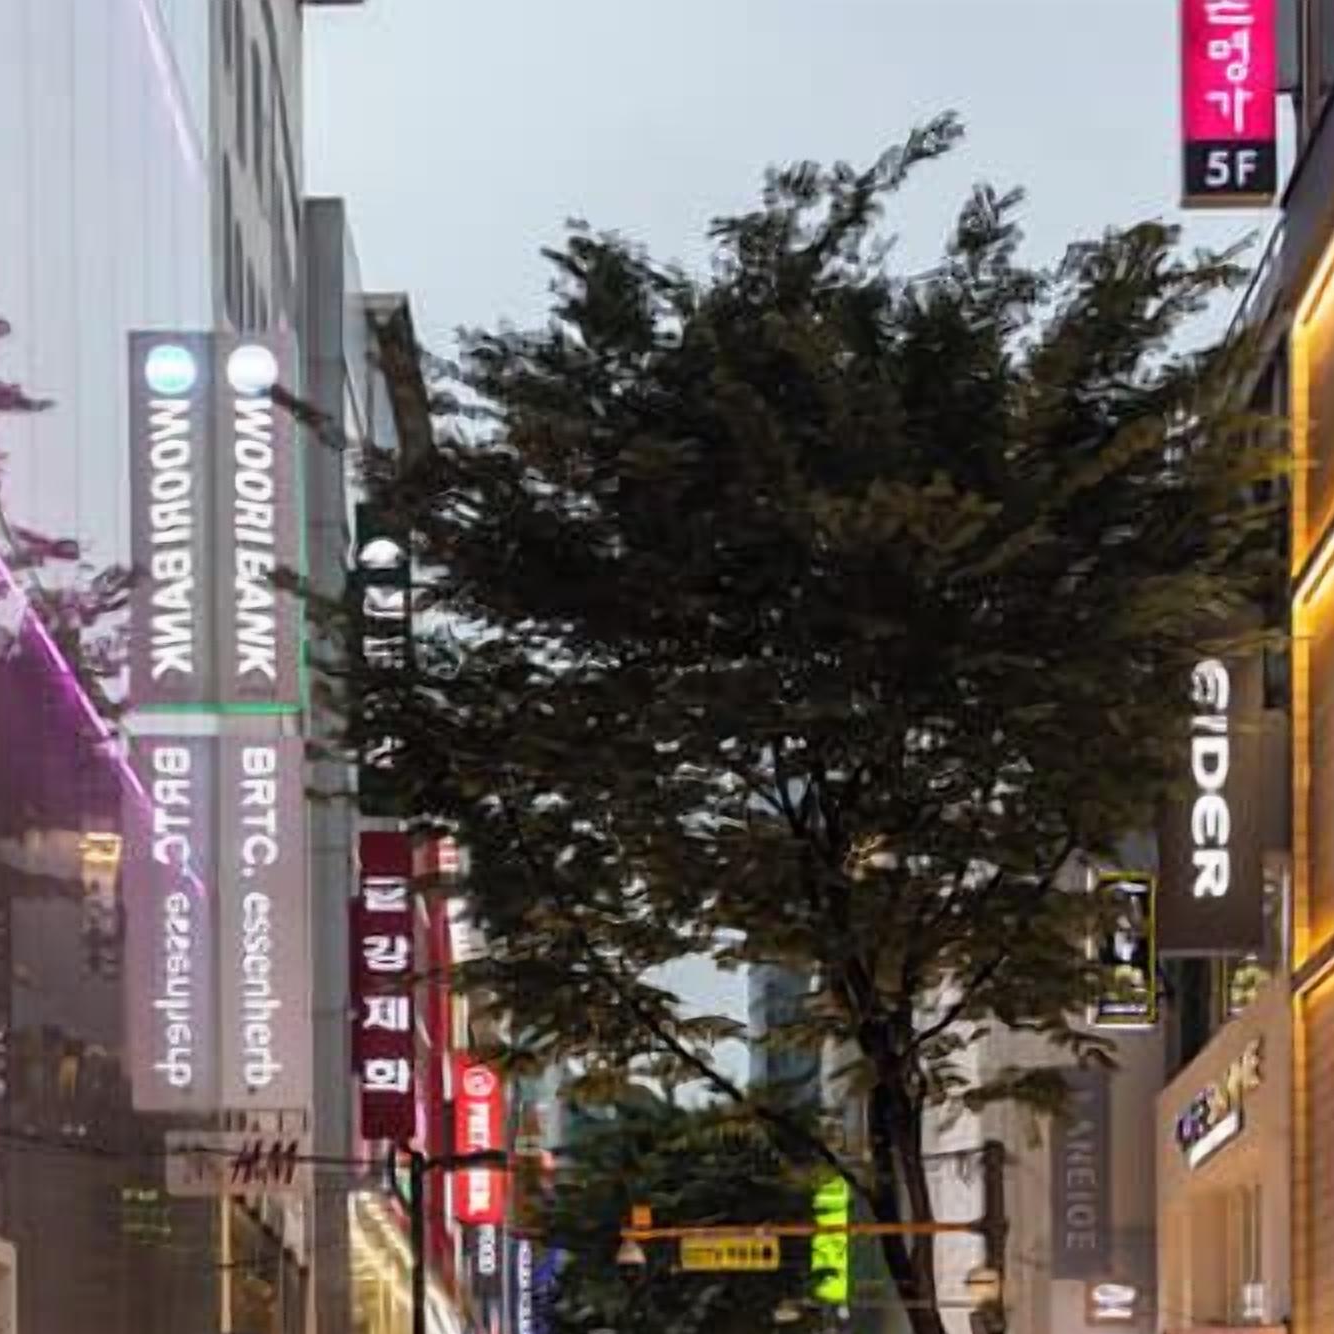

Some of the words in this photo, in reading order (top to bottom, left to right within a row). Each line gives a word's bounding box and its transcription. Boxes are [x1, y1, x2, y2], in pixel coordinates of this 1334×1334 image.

[1204, 148, 1258, 187] 5F
[233, 397, 275, 546] WOORI
[234, 548, 277, 682] BANK
[1191, 658, 1230, 899] EIDER
